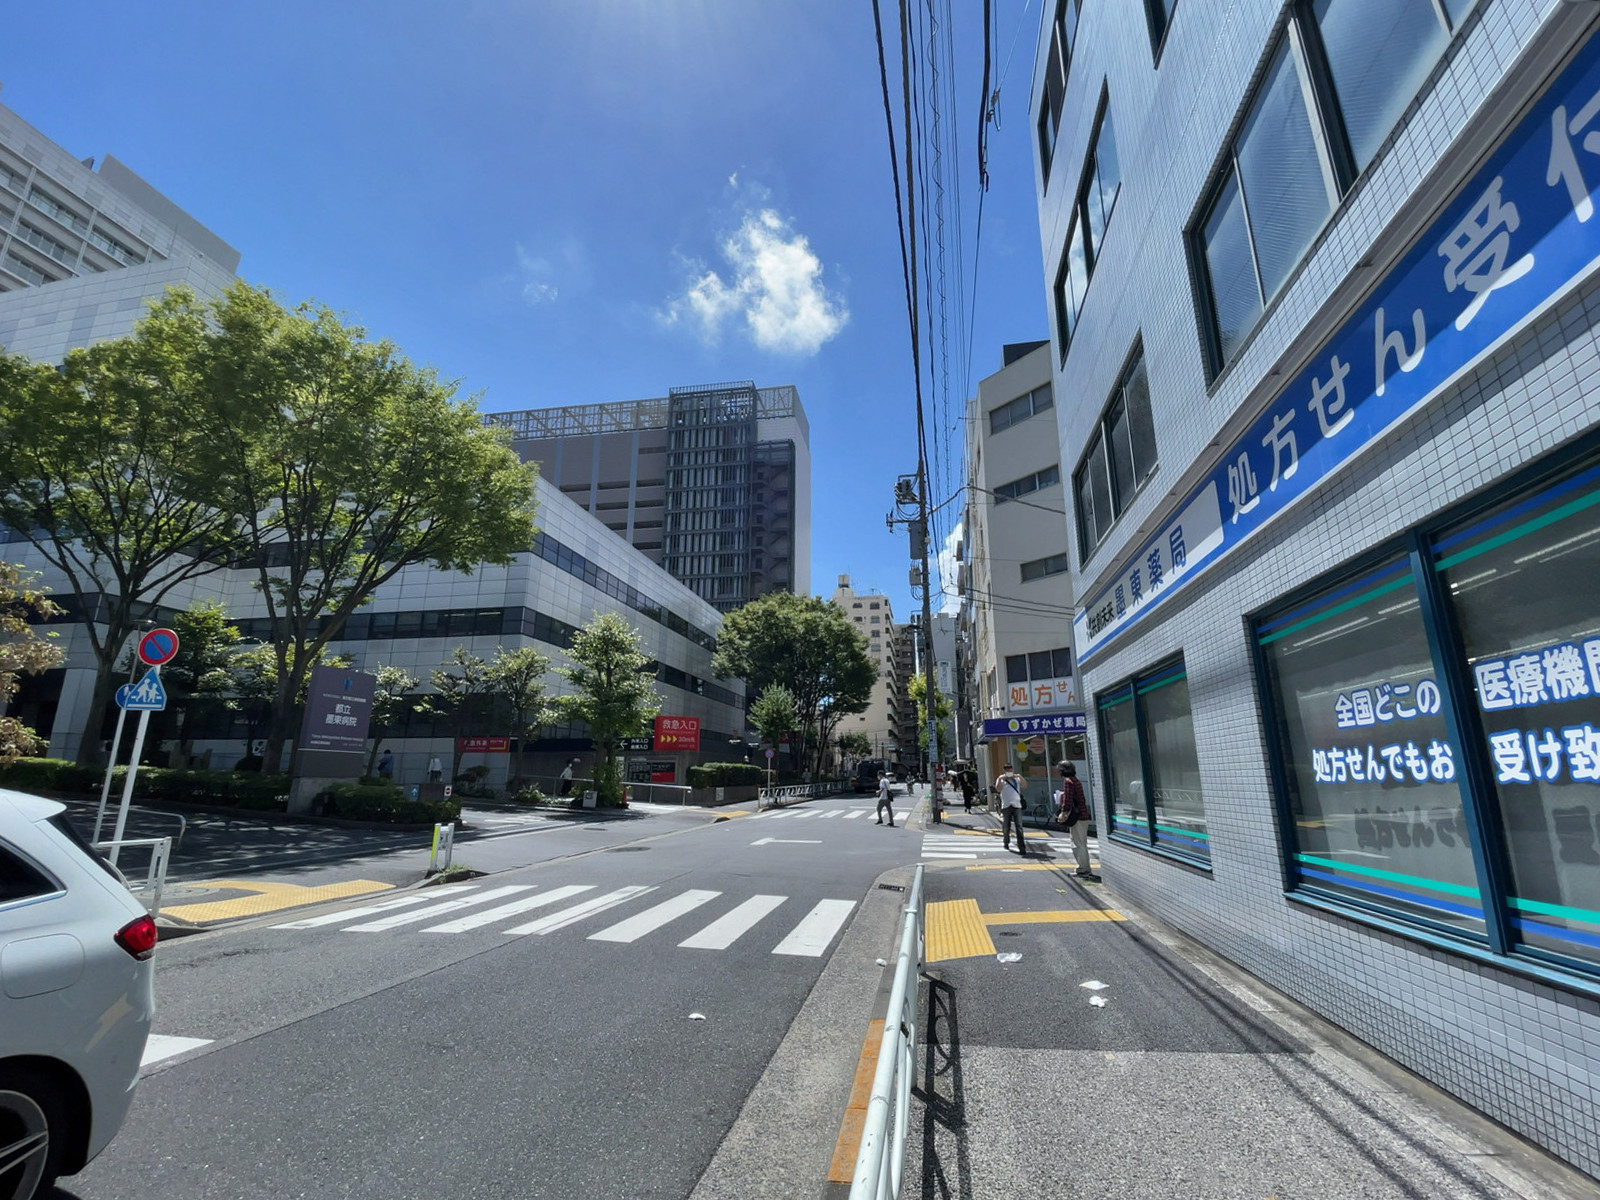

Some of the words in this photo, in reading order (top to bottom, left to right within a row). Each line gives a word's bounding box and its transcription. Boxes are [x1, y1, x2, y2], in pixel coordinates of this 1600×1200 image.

[1115, 525, 1187, 620] 墨東薬局
[1011, 681, 1076, 706] 処方せん
[1335, 680, 1442, 728] 全国どこの
[662, 719, 697, 730] 救急入口
[1020, 716, 1086, 730] すずかぜ薬局
[1312, 740, 1455, 782] 処方せんでもお
